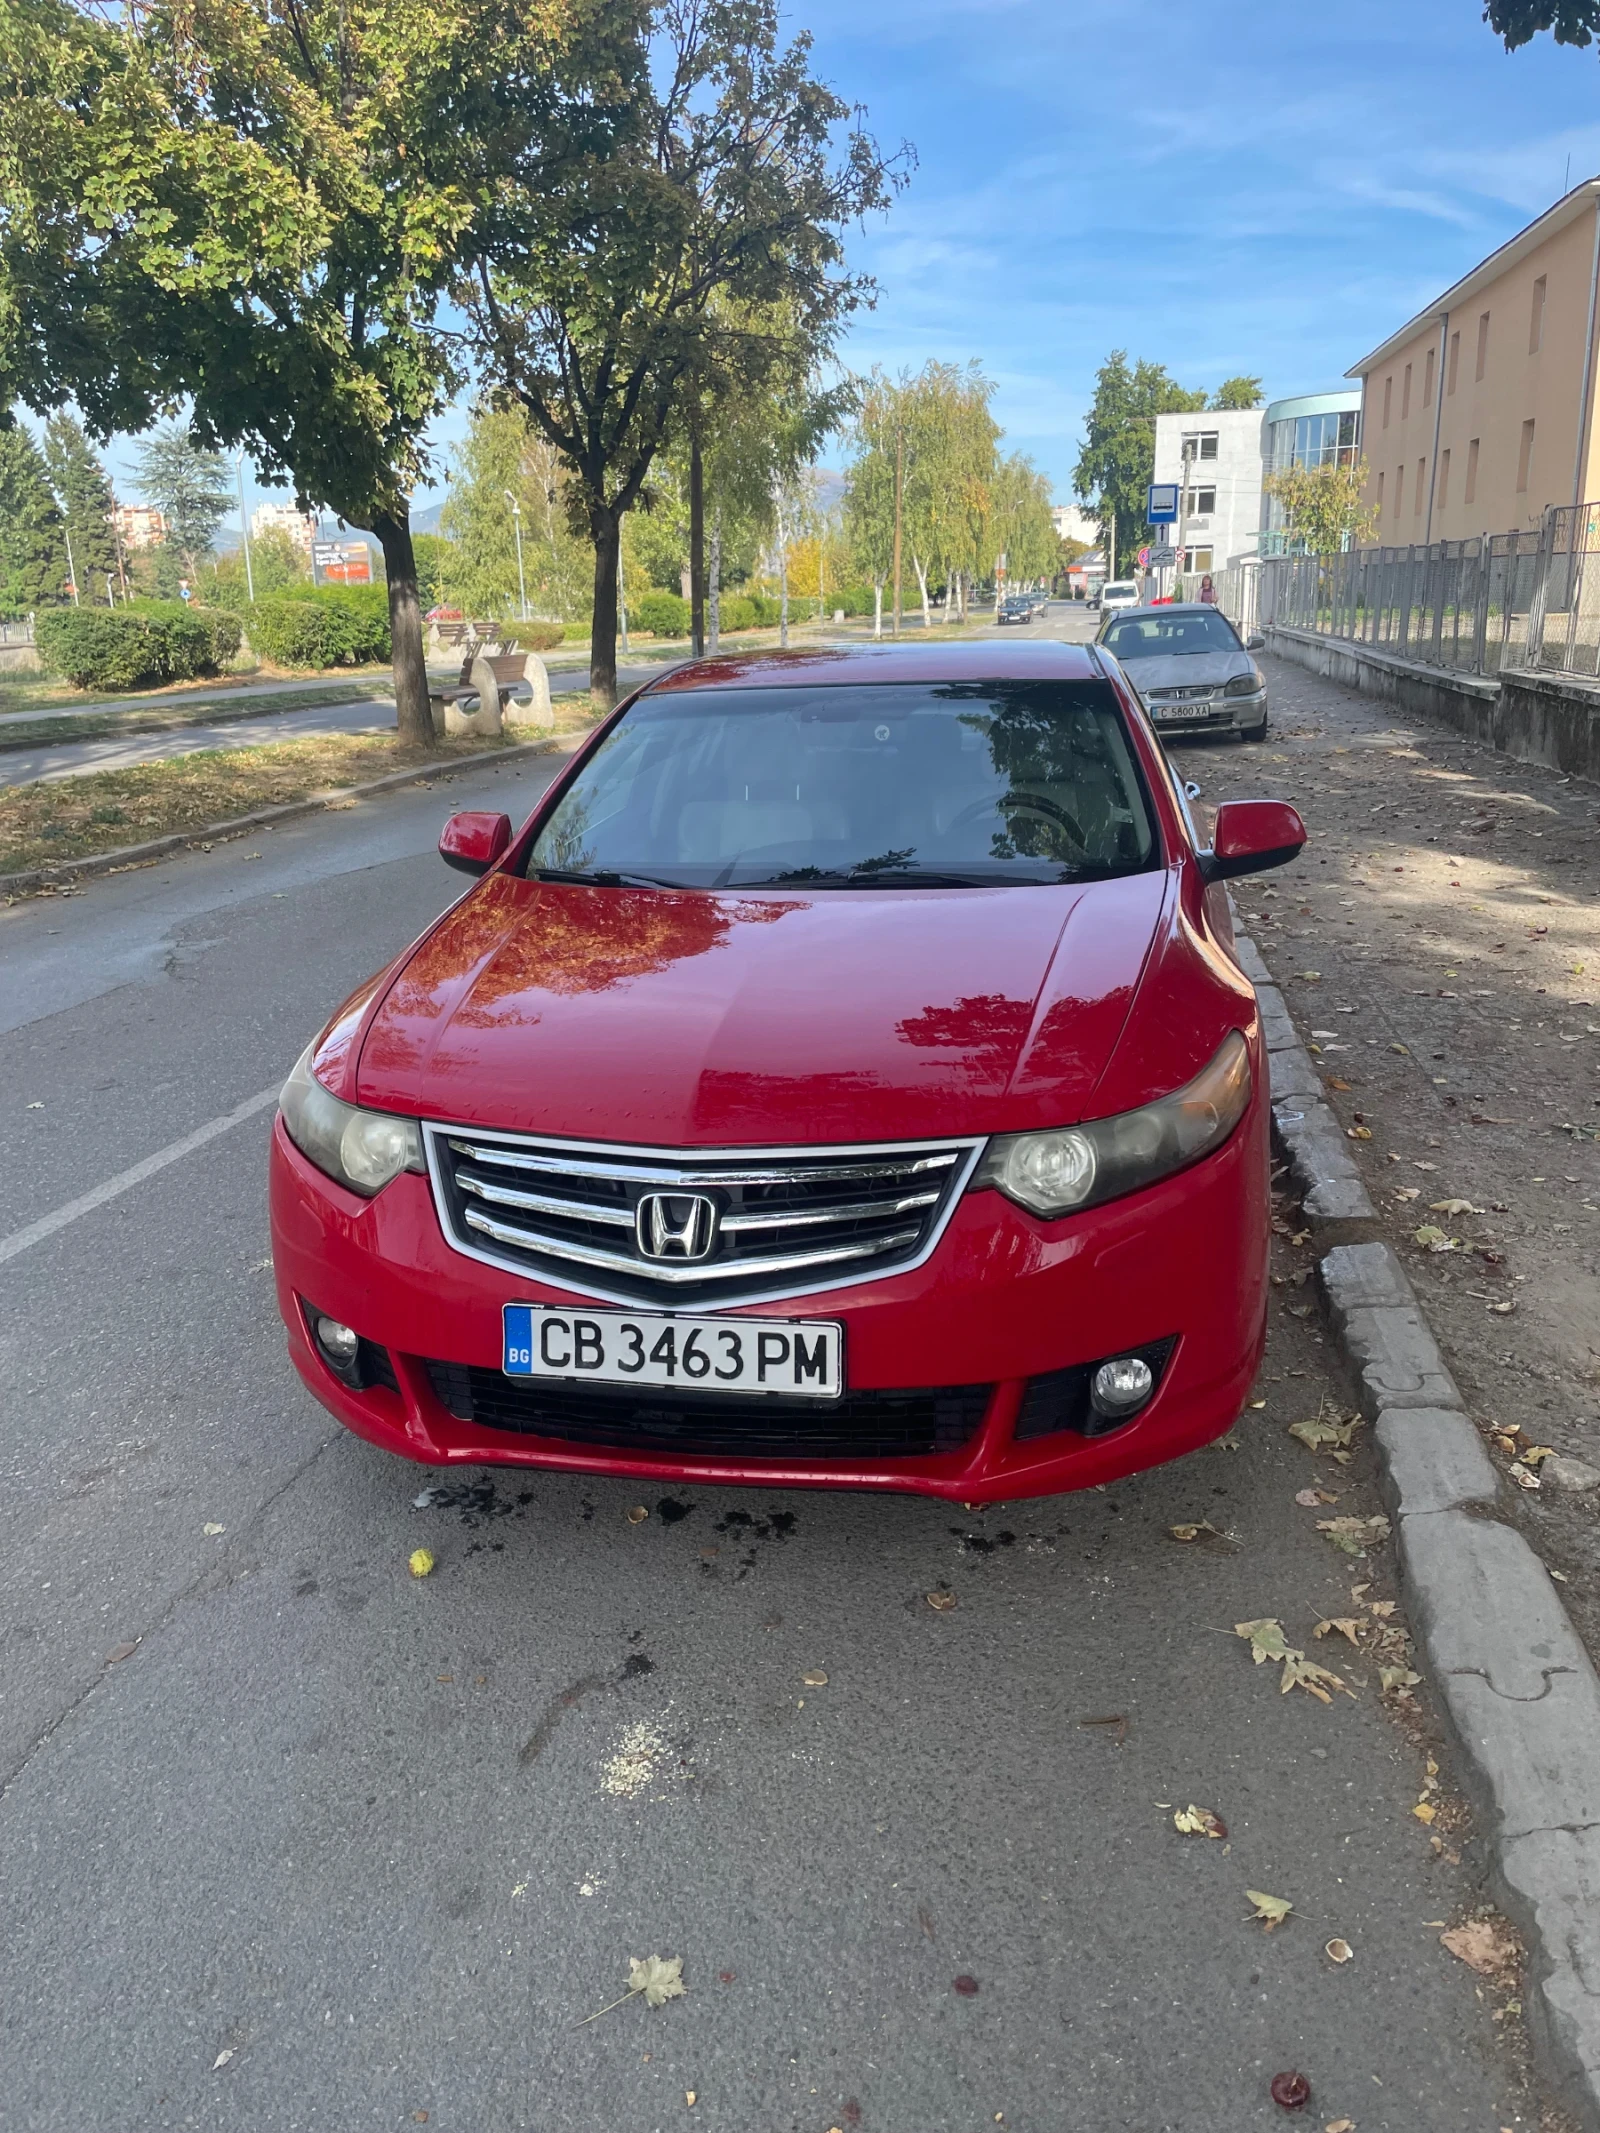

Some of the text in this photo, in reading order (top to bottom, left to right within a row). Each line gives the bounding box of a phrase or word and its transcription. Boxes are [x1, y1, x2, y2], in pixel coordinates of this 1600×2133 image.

[1161, 705, 1207, 718] C 5800 XA
[509, 1348, 529, 1363] BG
[540, 1317, 827, 1385] CB 3463 PM
